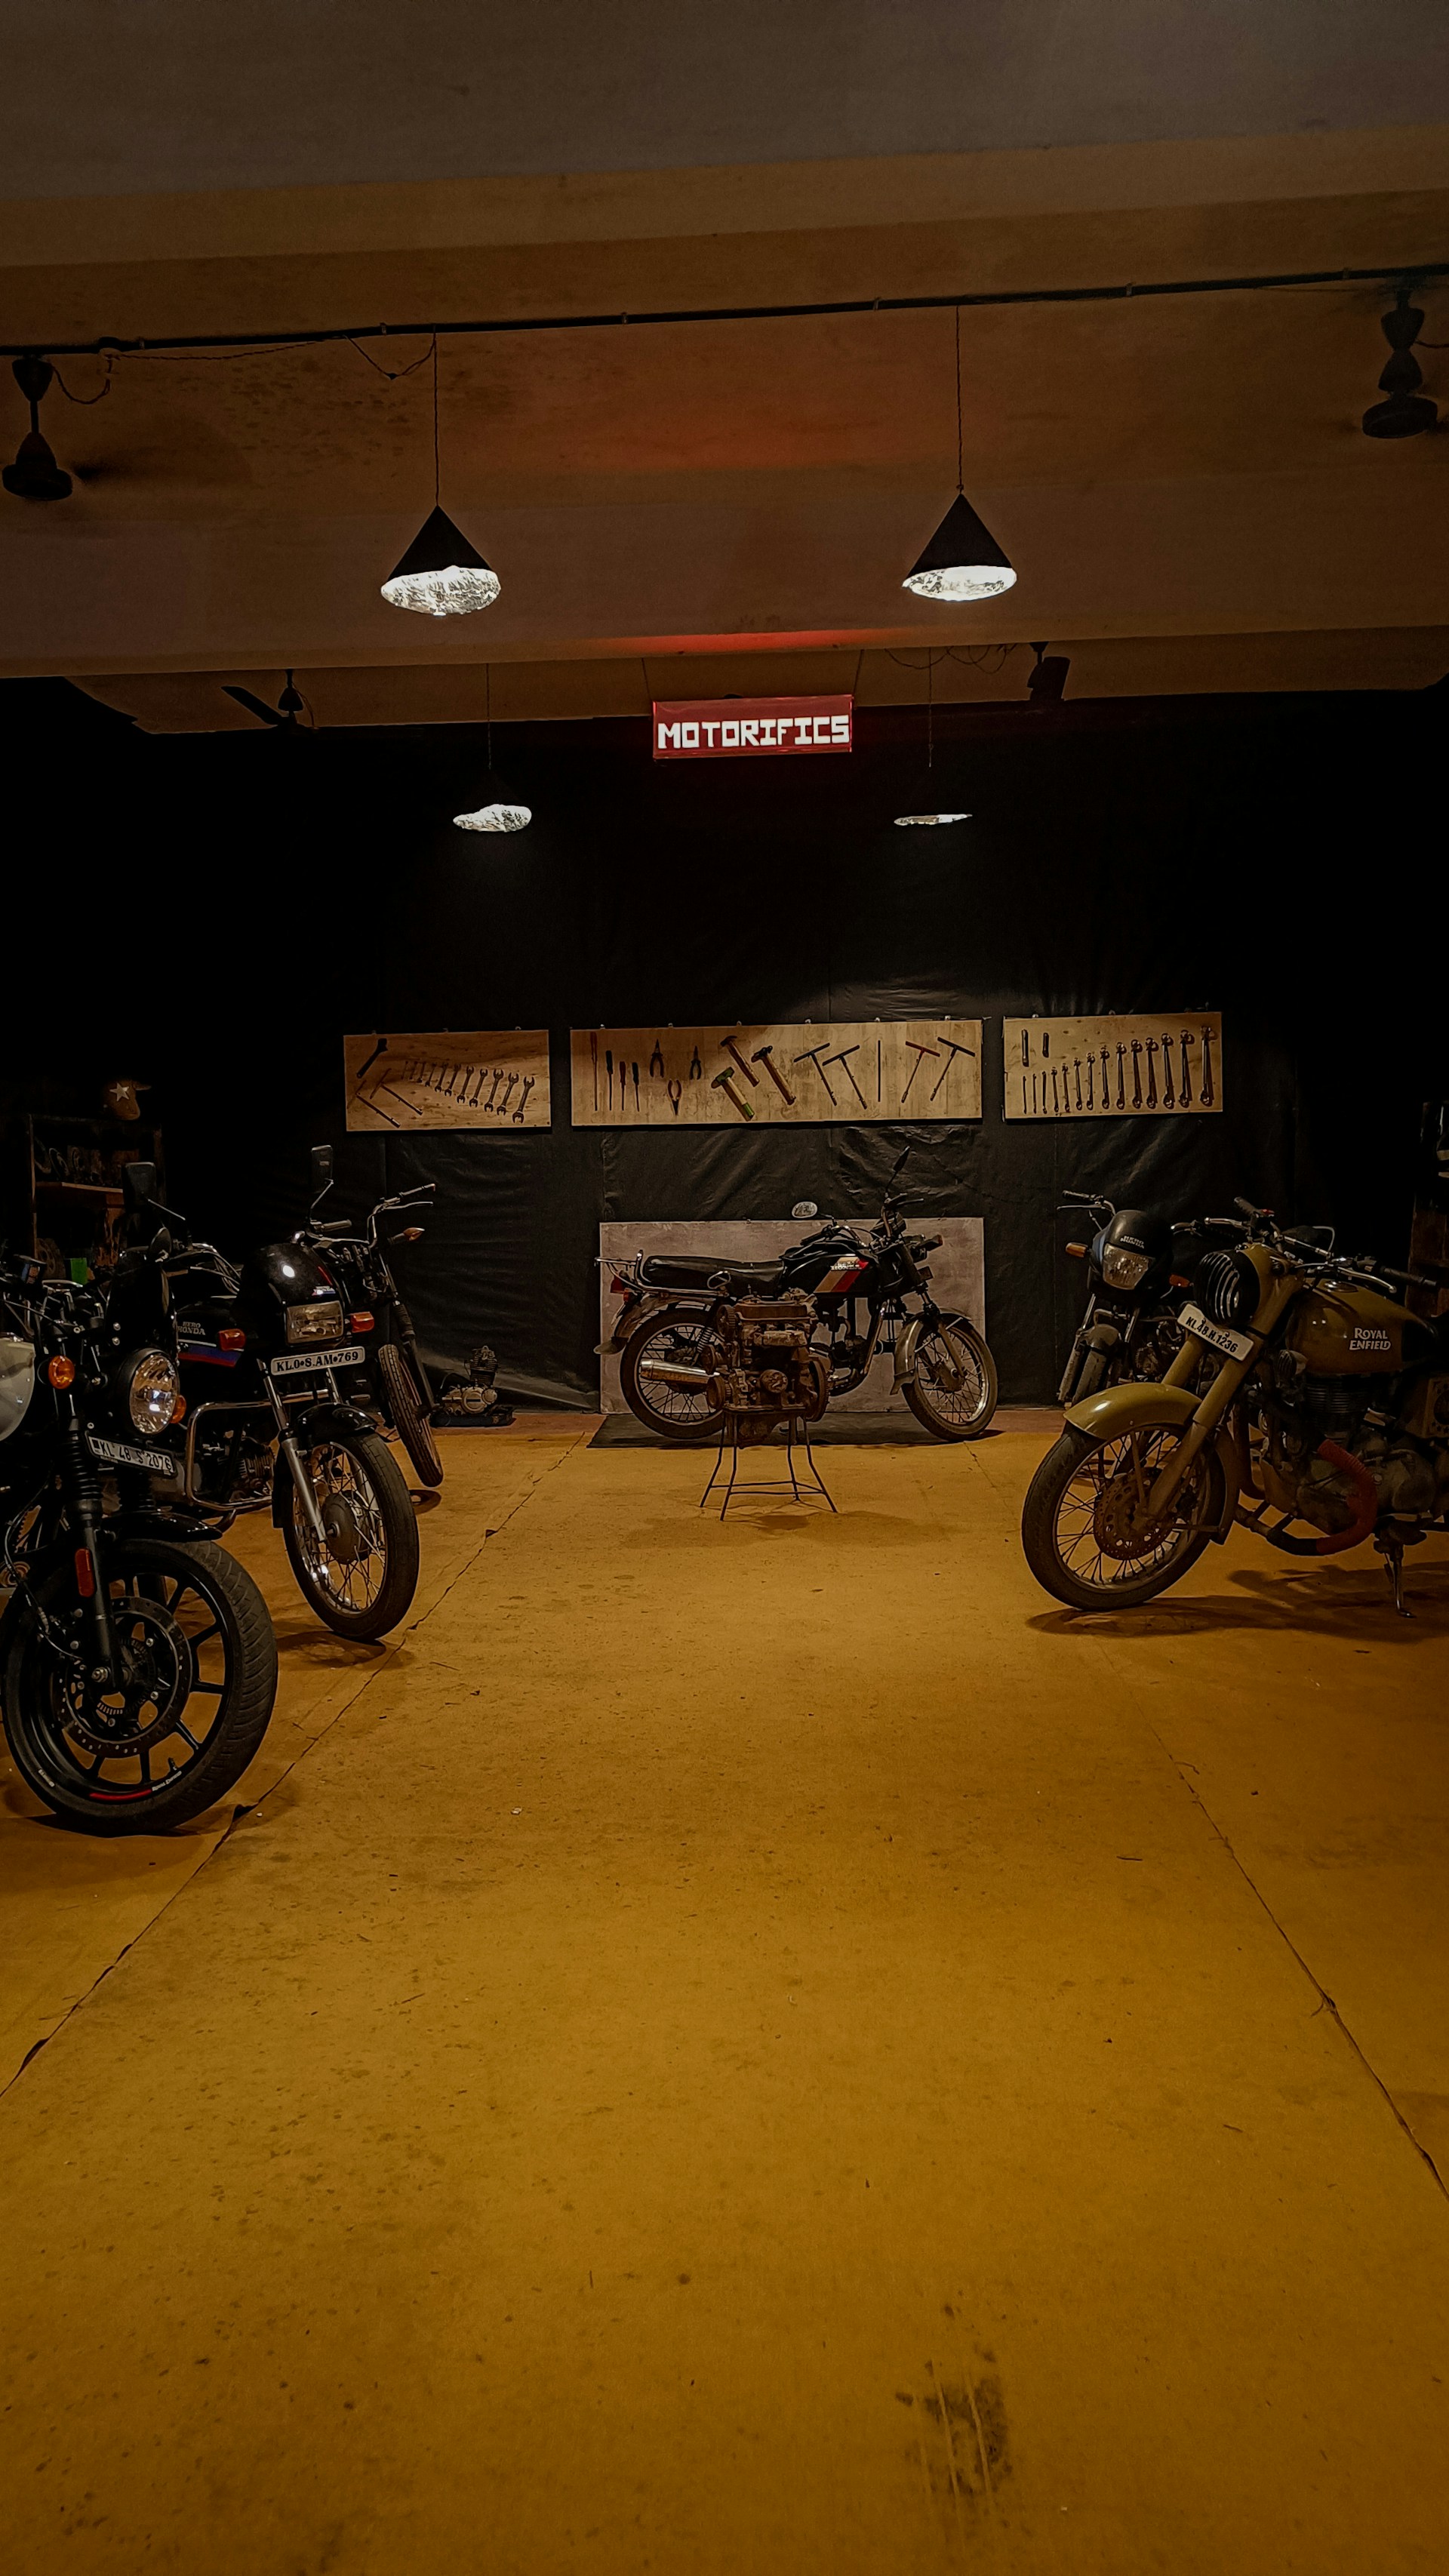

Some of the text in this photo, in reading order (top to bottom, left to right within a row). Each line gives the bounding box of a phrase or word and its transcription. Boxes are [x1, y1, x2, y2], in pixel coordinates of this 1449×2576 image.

[657, 715, 850, 749] MOTORIFICS
[1354, 1327, 1389, 1340] ROYAL
[1349, 1340, 1392, 1350] ENFIELD
